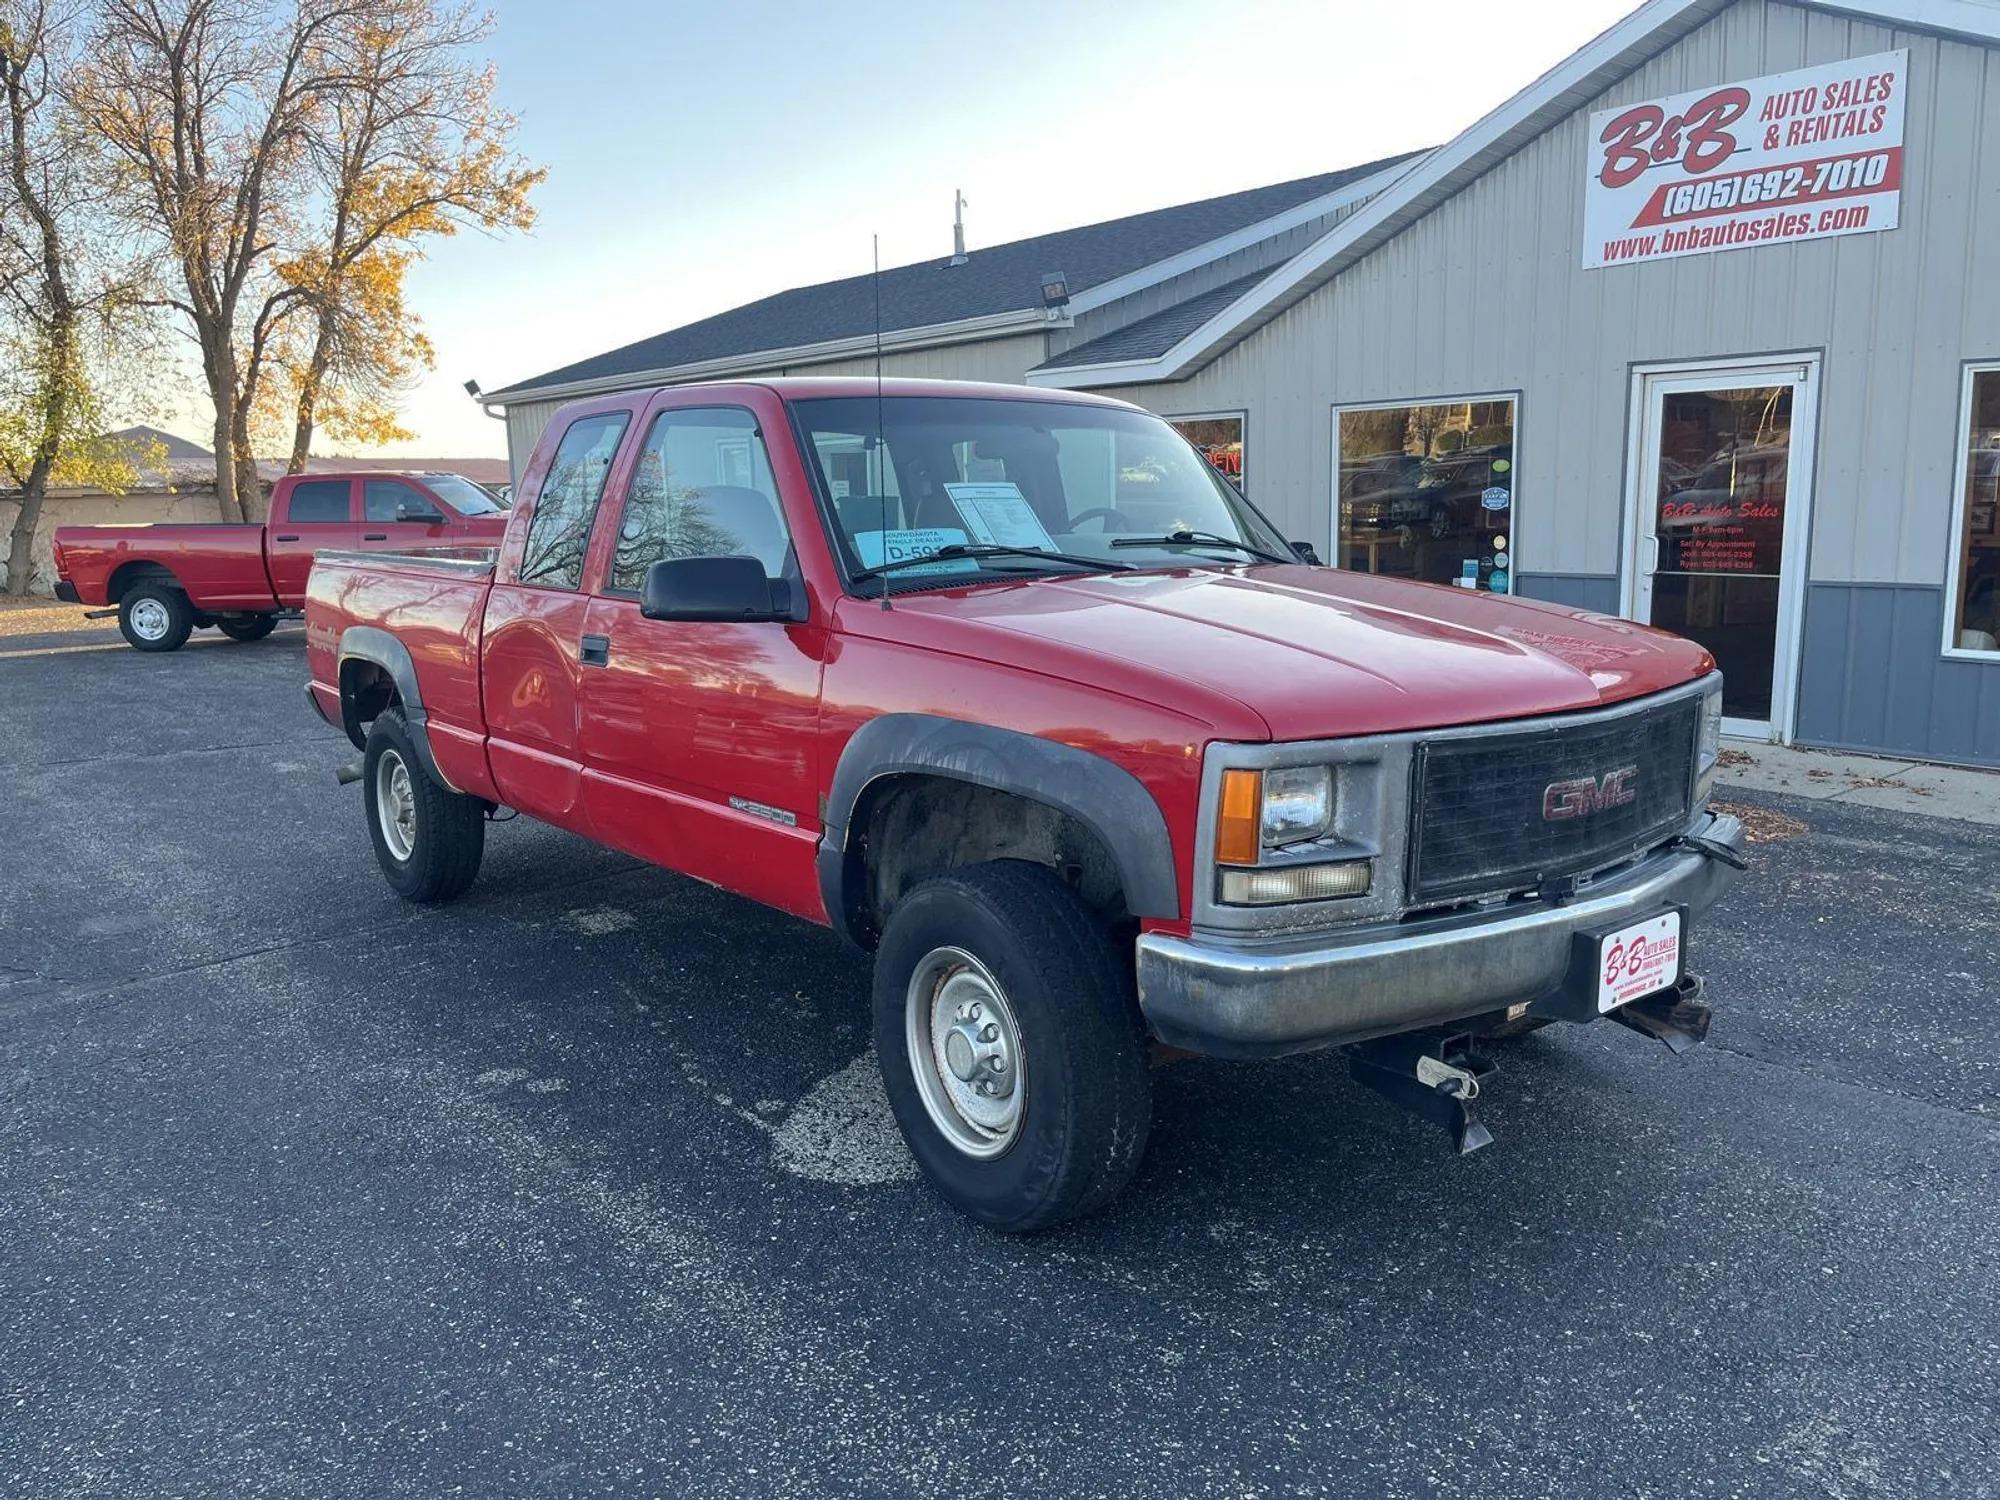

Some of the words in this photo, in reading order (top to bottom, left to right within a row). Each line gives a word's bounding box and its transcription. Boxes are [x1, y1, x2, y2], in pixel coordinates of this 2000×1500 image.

[1759, 87, 1818, 122] AUTO
[1822, 72, 1895, 109] SALES
[1599, 87, 1751, 189] B&B
[1763, 124, 1780, 151] &
[1785, 104, 1887, 147] RENTALS
[1661, 154, 1890, 219] (605)692-7010
[1603, 204, 1870, 262] www.bnbautosales.com
[1700, 502, 1733, 517] Auto
[1737, 502, 1779, 517] Sales
[1543, 764, 1640, 821] GMC
[1658, 935, 1676, 951] SALES
